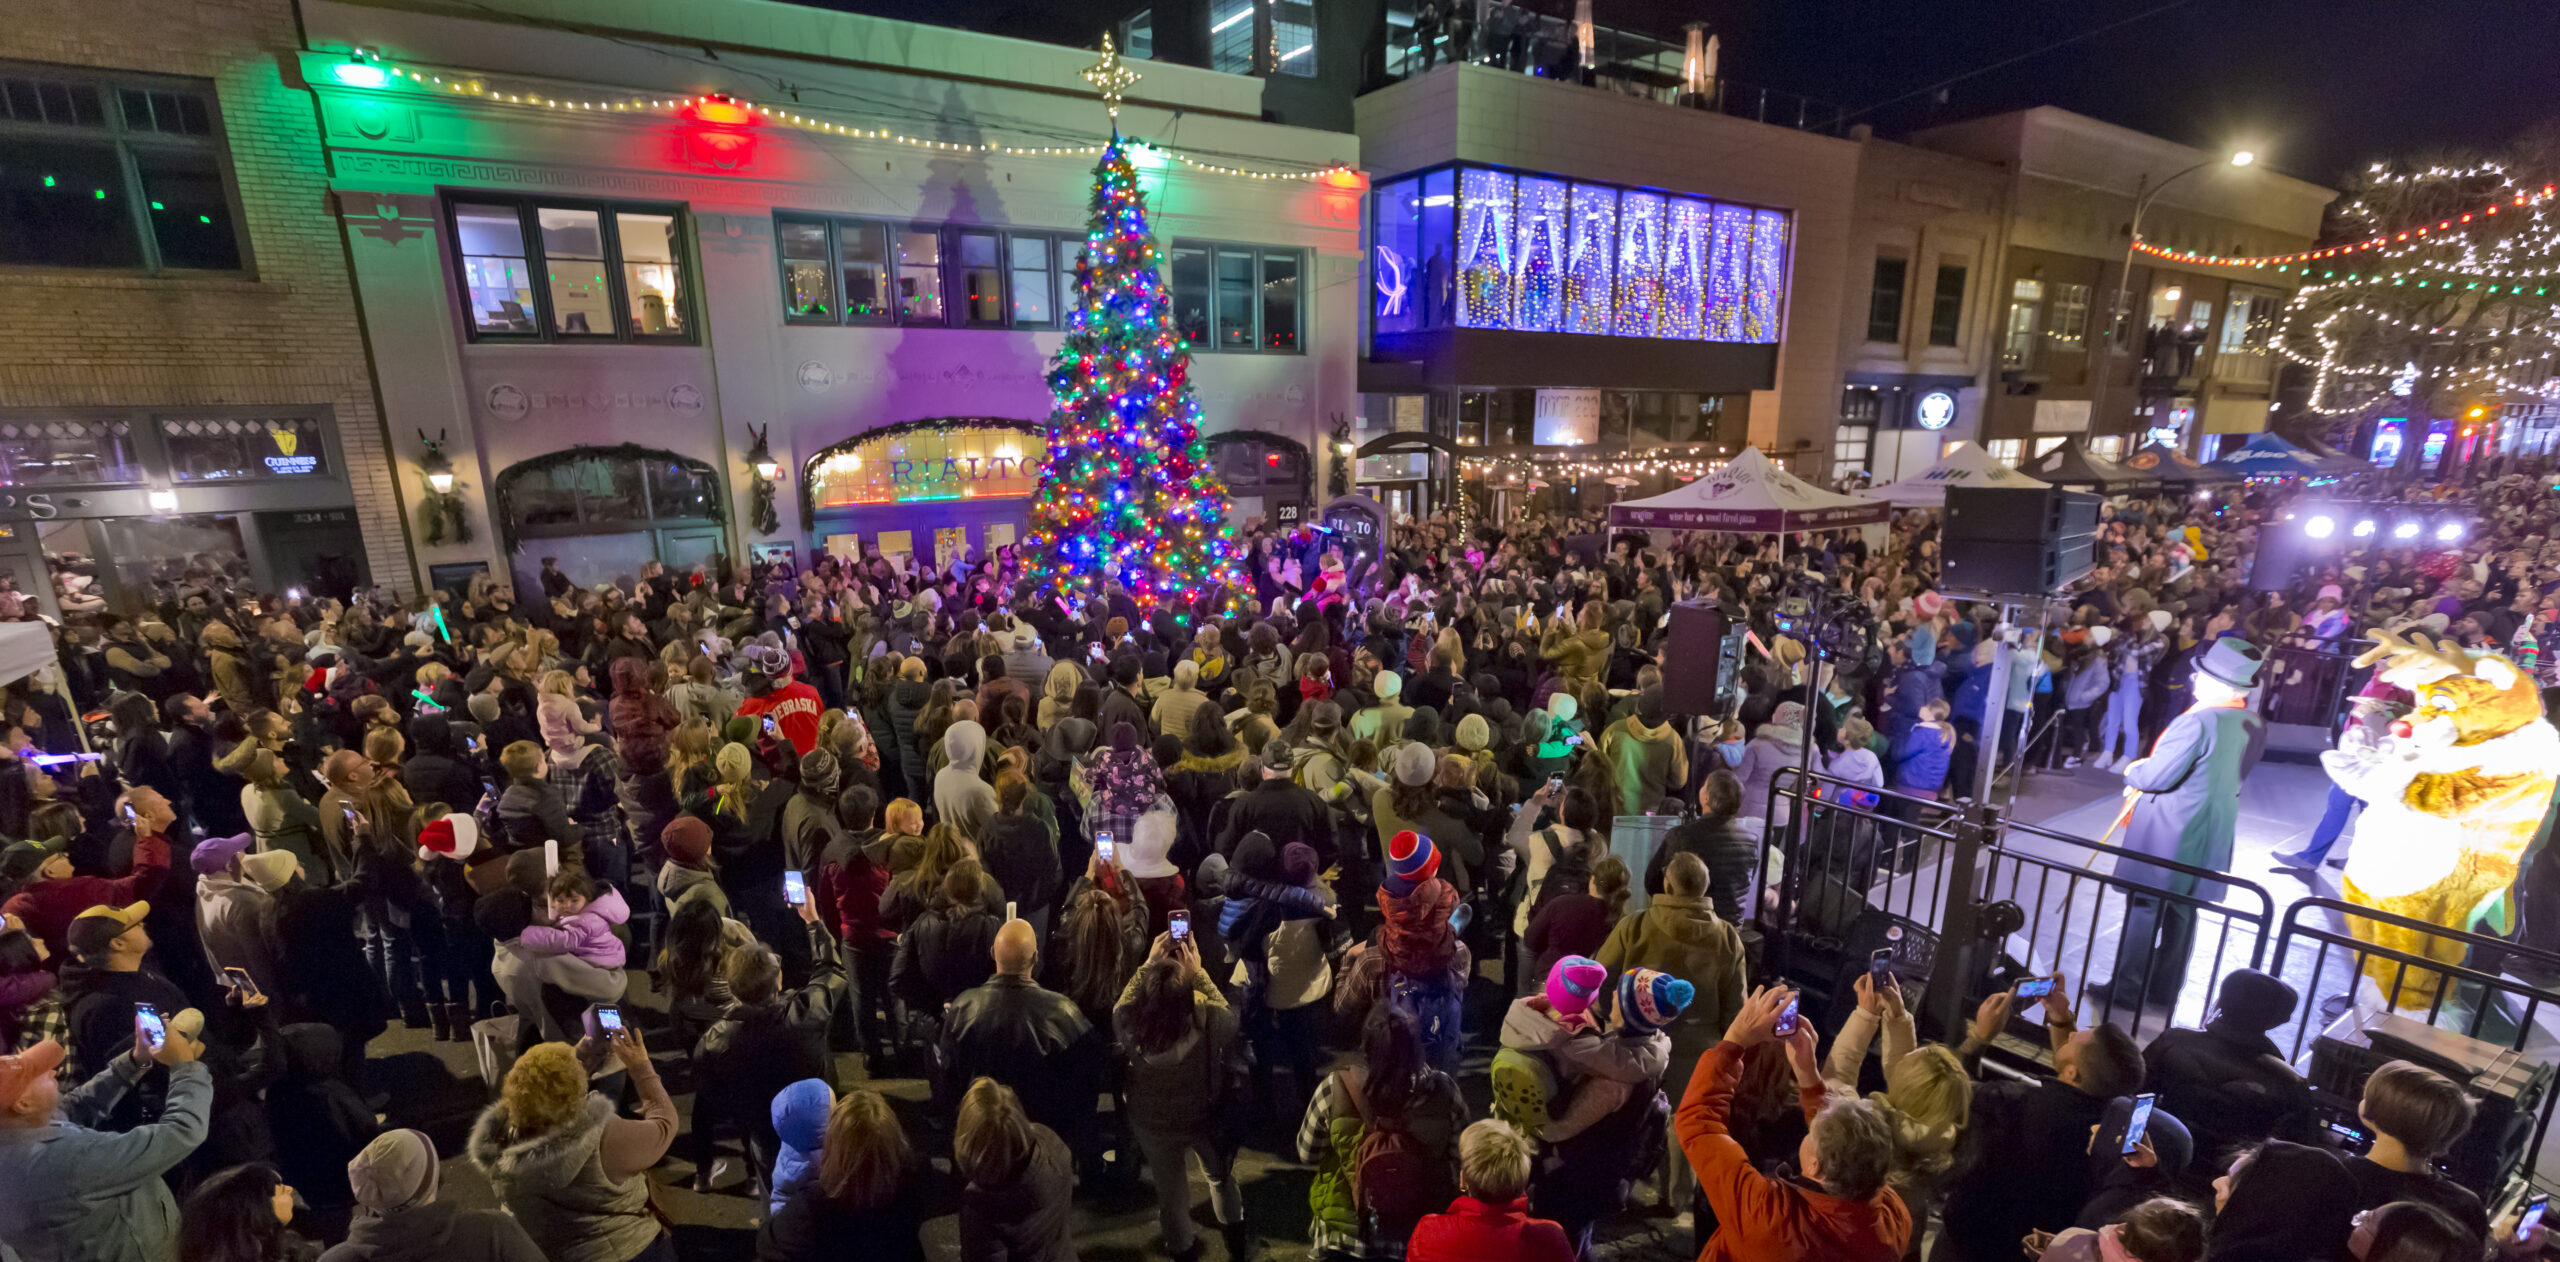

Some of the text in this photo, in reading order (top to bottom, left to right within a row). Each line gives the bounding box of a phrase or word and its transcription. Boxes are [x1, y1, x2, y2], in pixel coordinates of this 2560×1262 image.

[264, 456, 317, 467] GUINNESS
[890, 456, 1040, 484] RIALTO
[1280, 506, 1298, 519] 228
[1332, 518, 1371, 535] RITO
